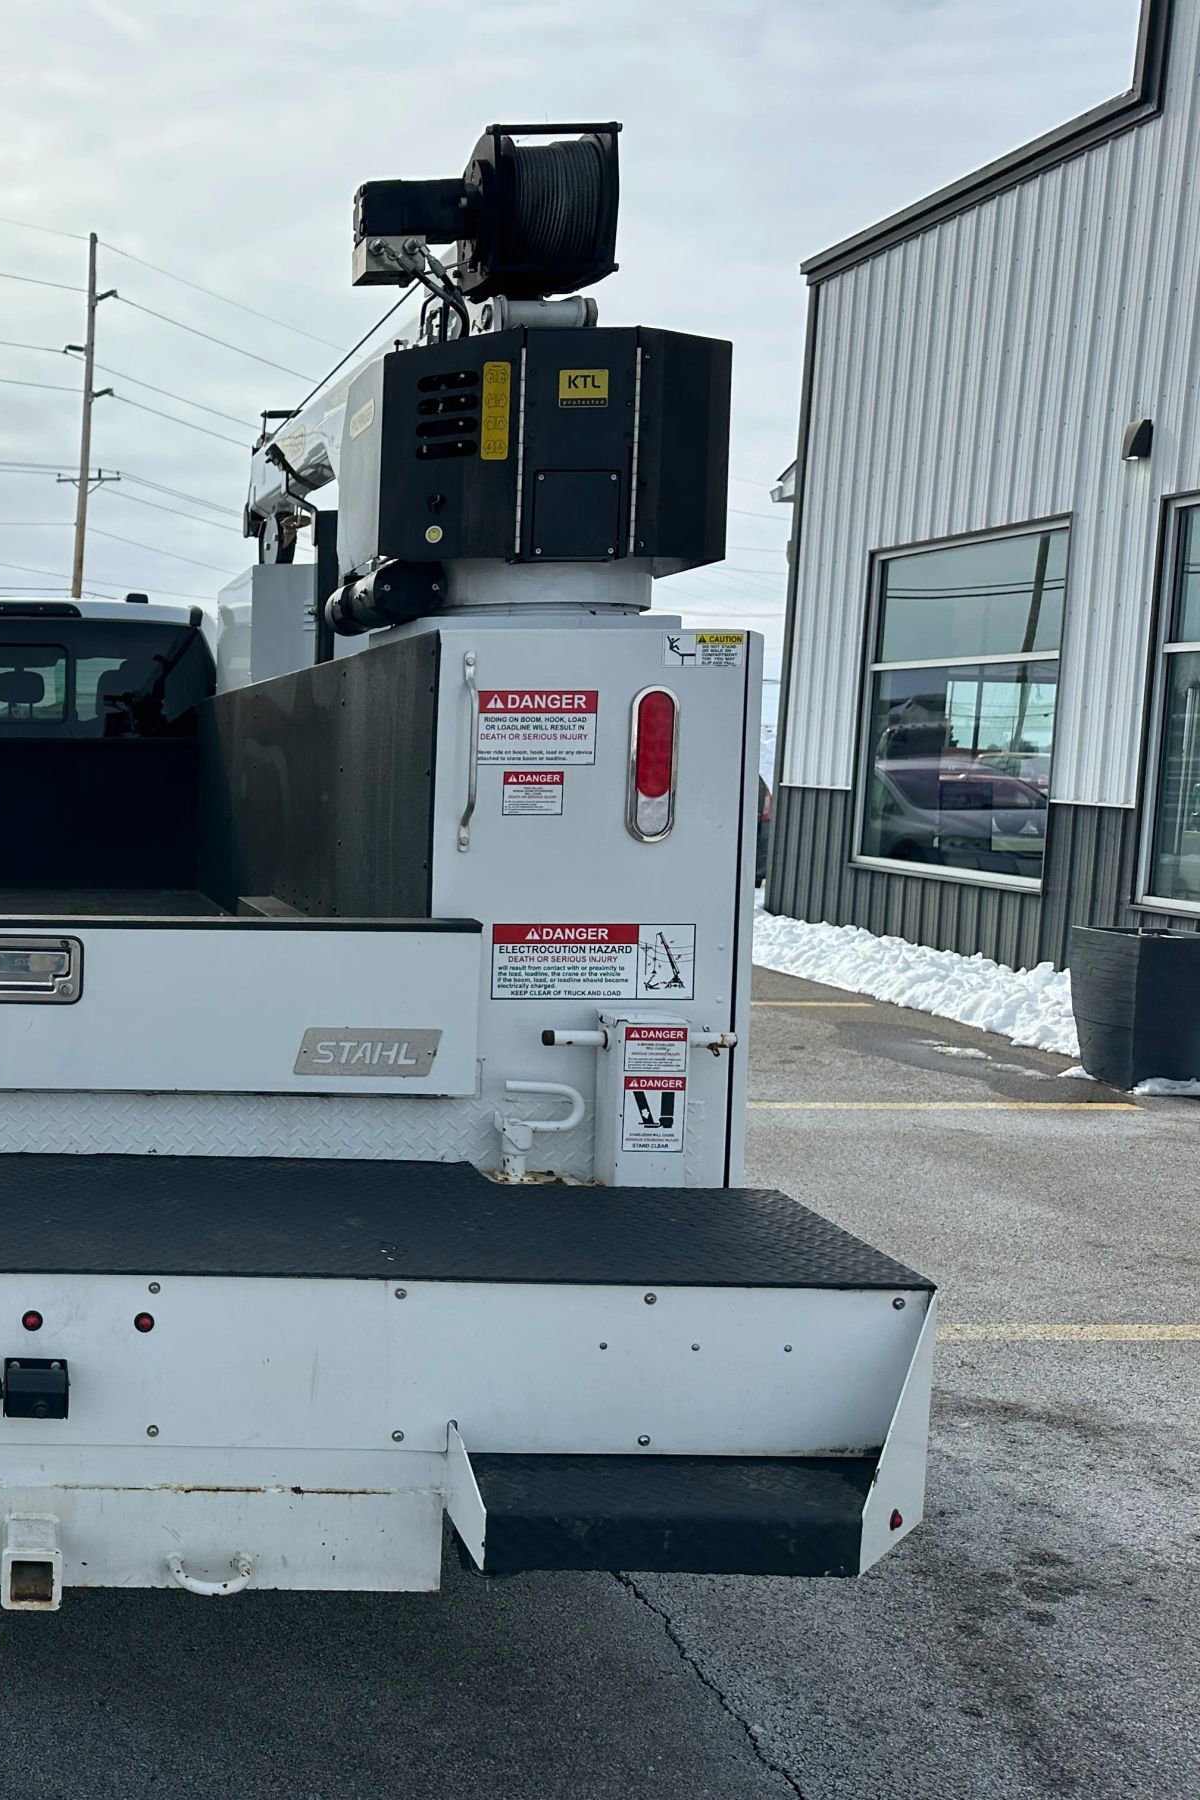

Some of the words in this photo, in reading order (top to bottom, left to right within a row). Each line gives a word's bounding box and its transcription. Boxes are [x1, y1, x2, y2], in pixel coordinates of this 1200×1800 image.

[568, 375, 600, 388] KTL
[507, 694, 586, 709] DANGER
[542, 928, 609, 940] DANGER
[499, 945, 586, 954] ELECTROCUTION
[589, 945, 632, 954] HAZARD
[641, 1030, 684, 1039] DANGER
[312, 1042, 417, 1065] STAHL
[640, 1079, 683, 1088] DANGER
